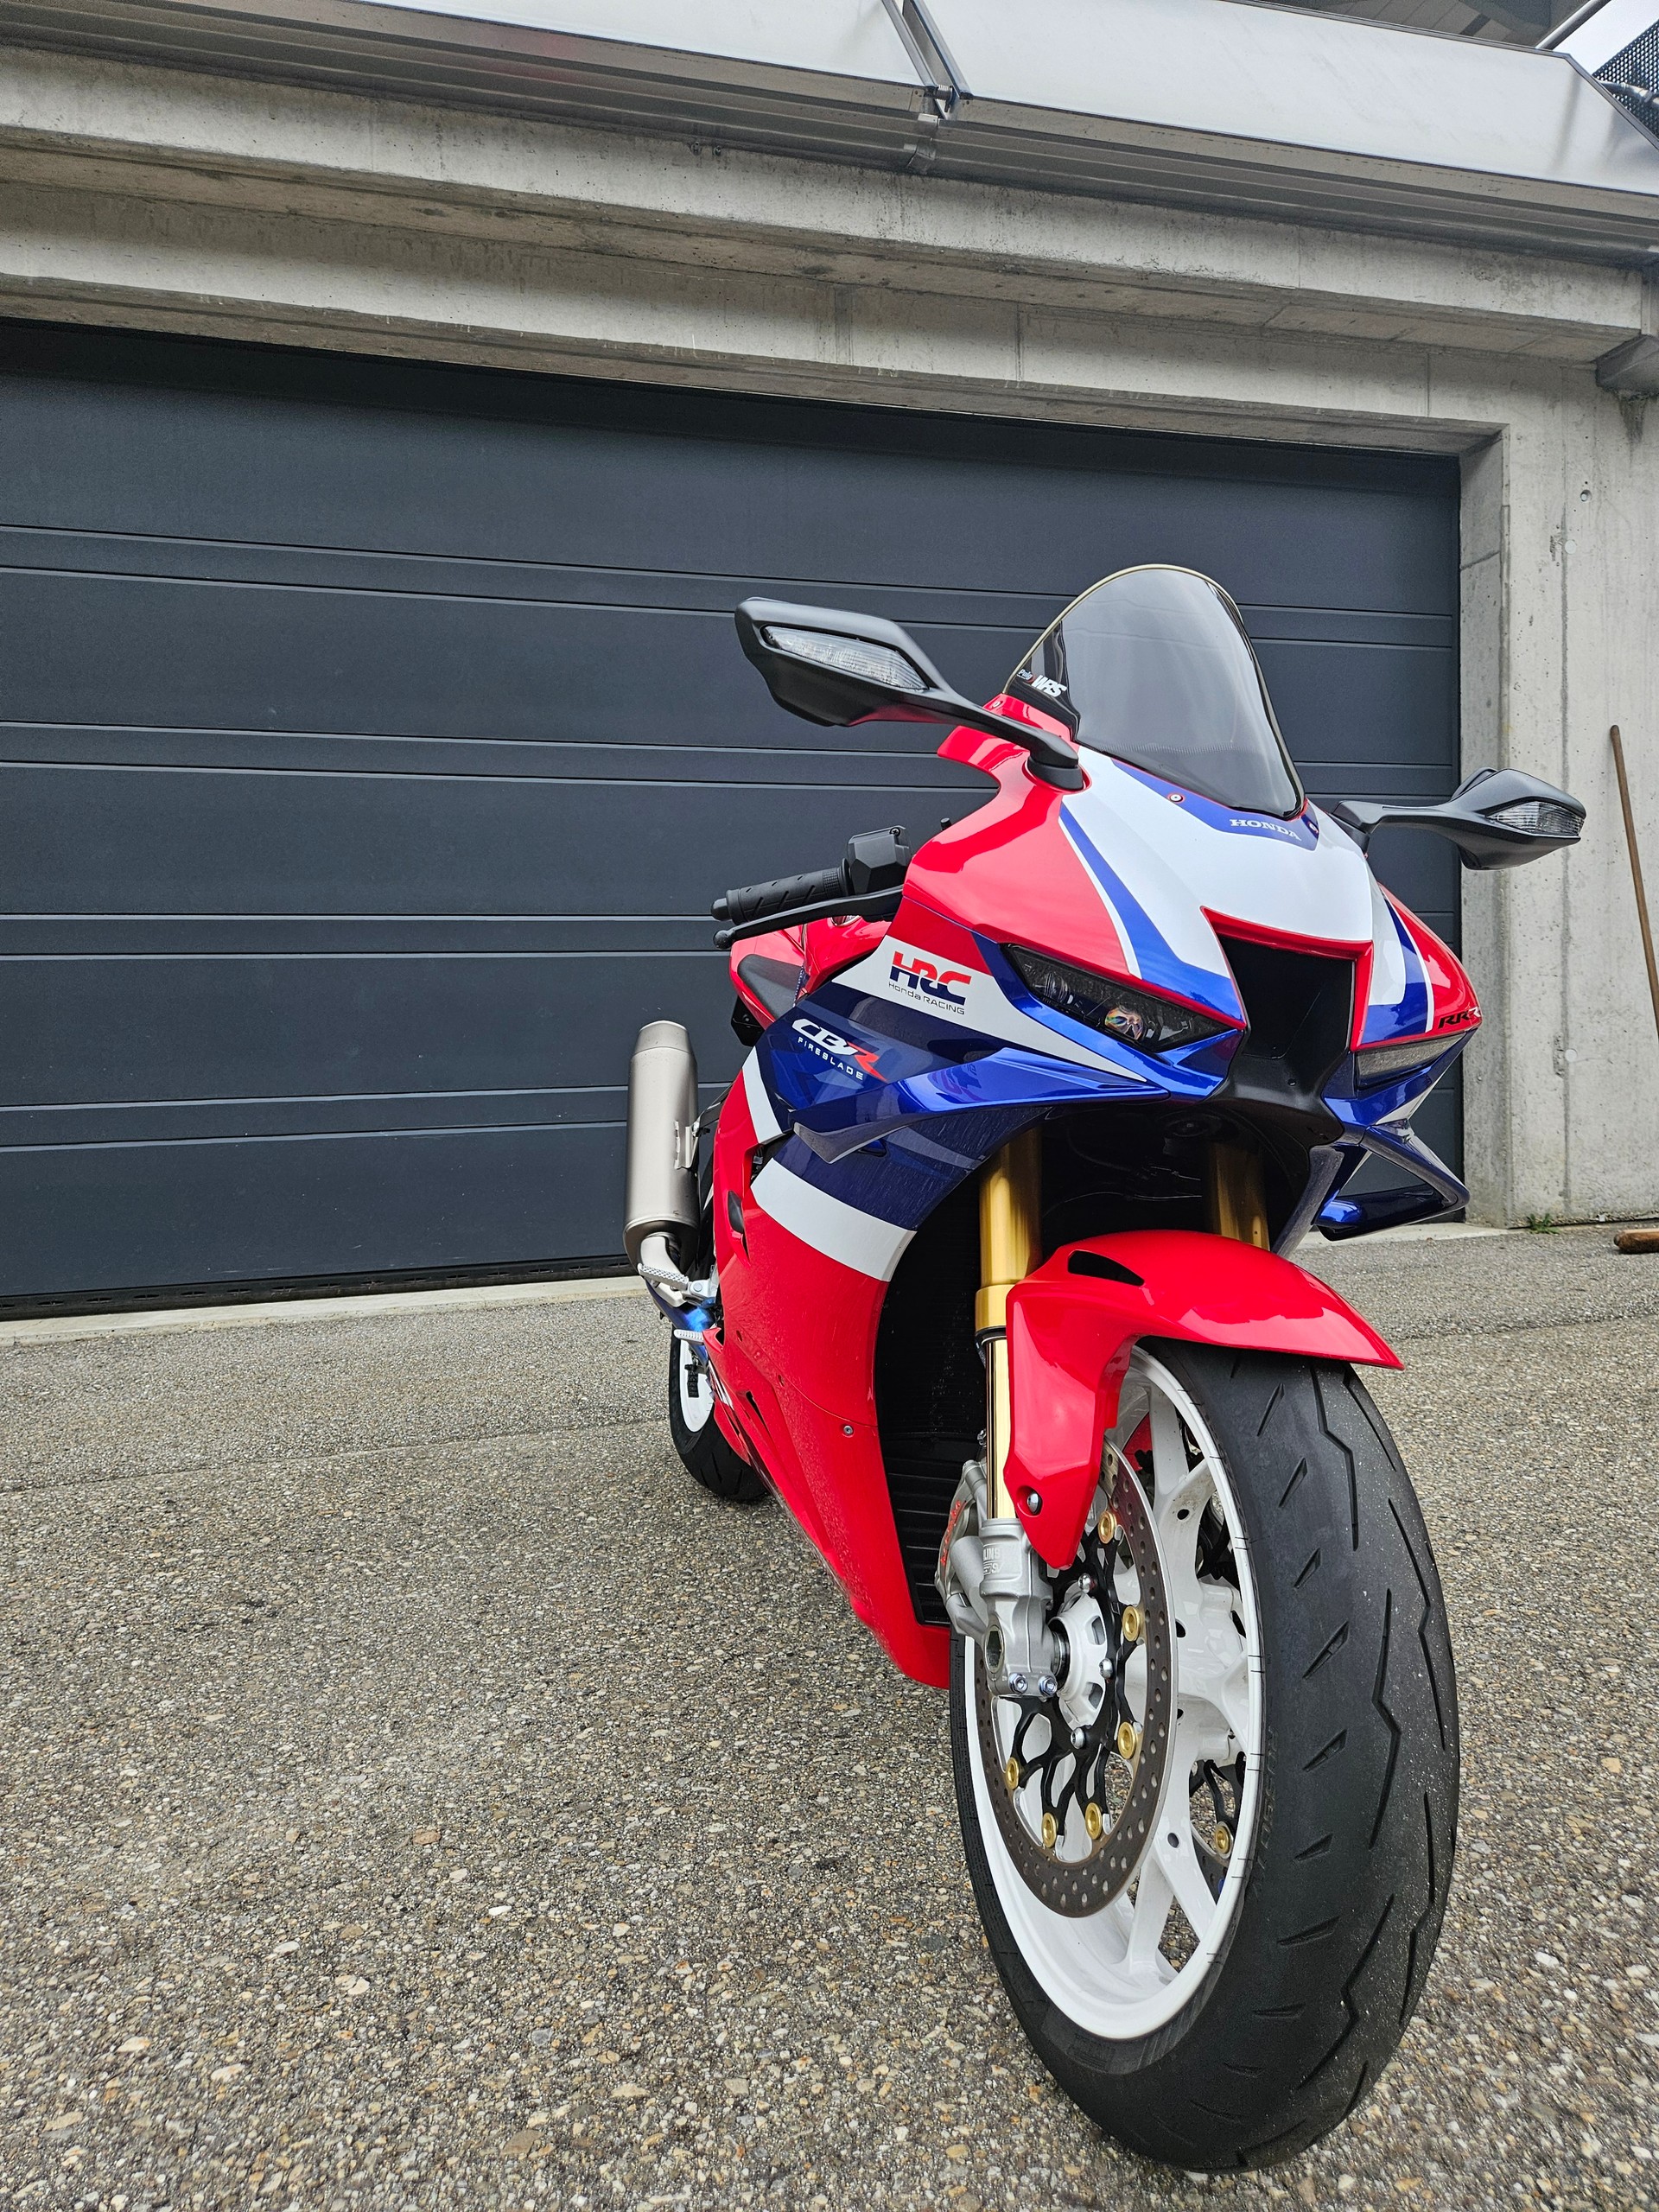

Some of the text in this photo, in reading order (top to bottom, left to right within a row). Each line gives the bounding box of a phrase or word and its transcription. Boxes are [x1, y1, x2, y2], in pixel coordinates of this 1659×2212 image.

[1031, 675, 1067, 697] WRS
[1230, 819, 1301, 842] HONDA
[889, 950, 971, 1006] HRC
[888, 982, 965, 1014] Honda RACING
[791, 1018, 887, 1084] CBR
[798, 1036, 863, 1080] FIREBLADE
